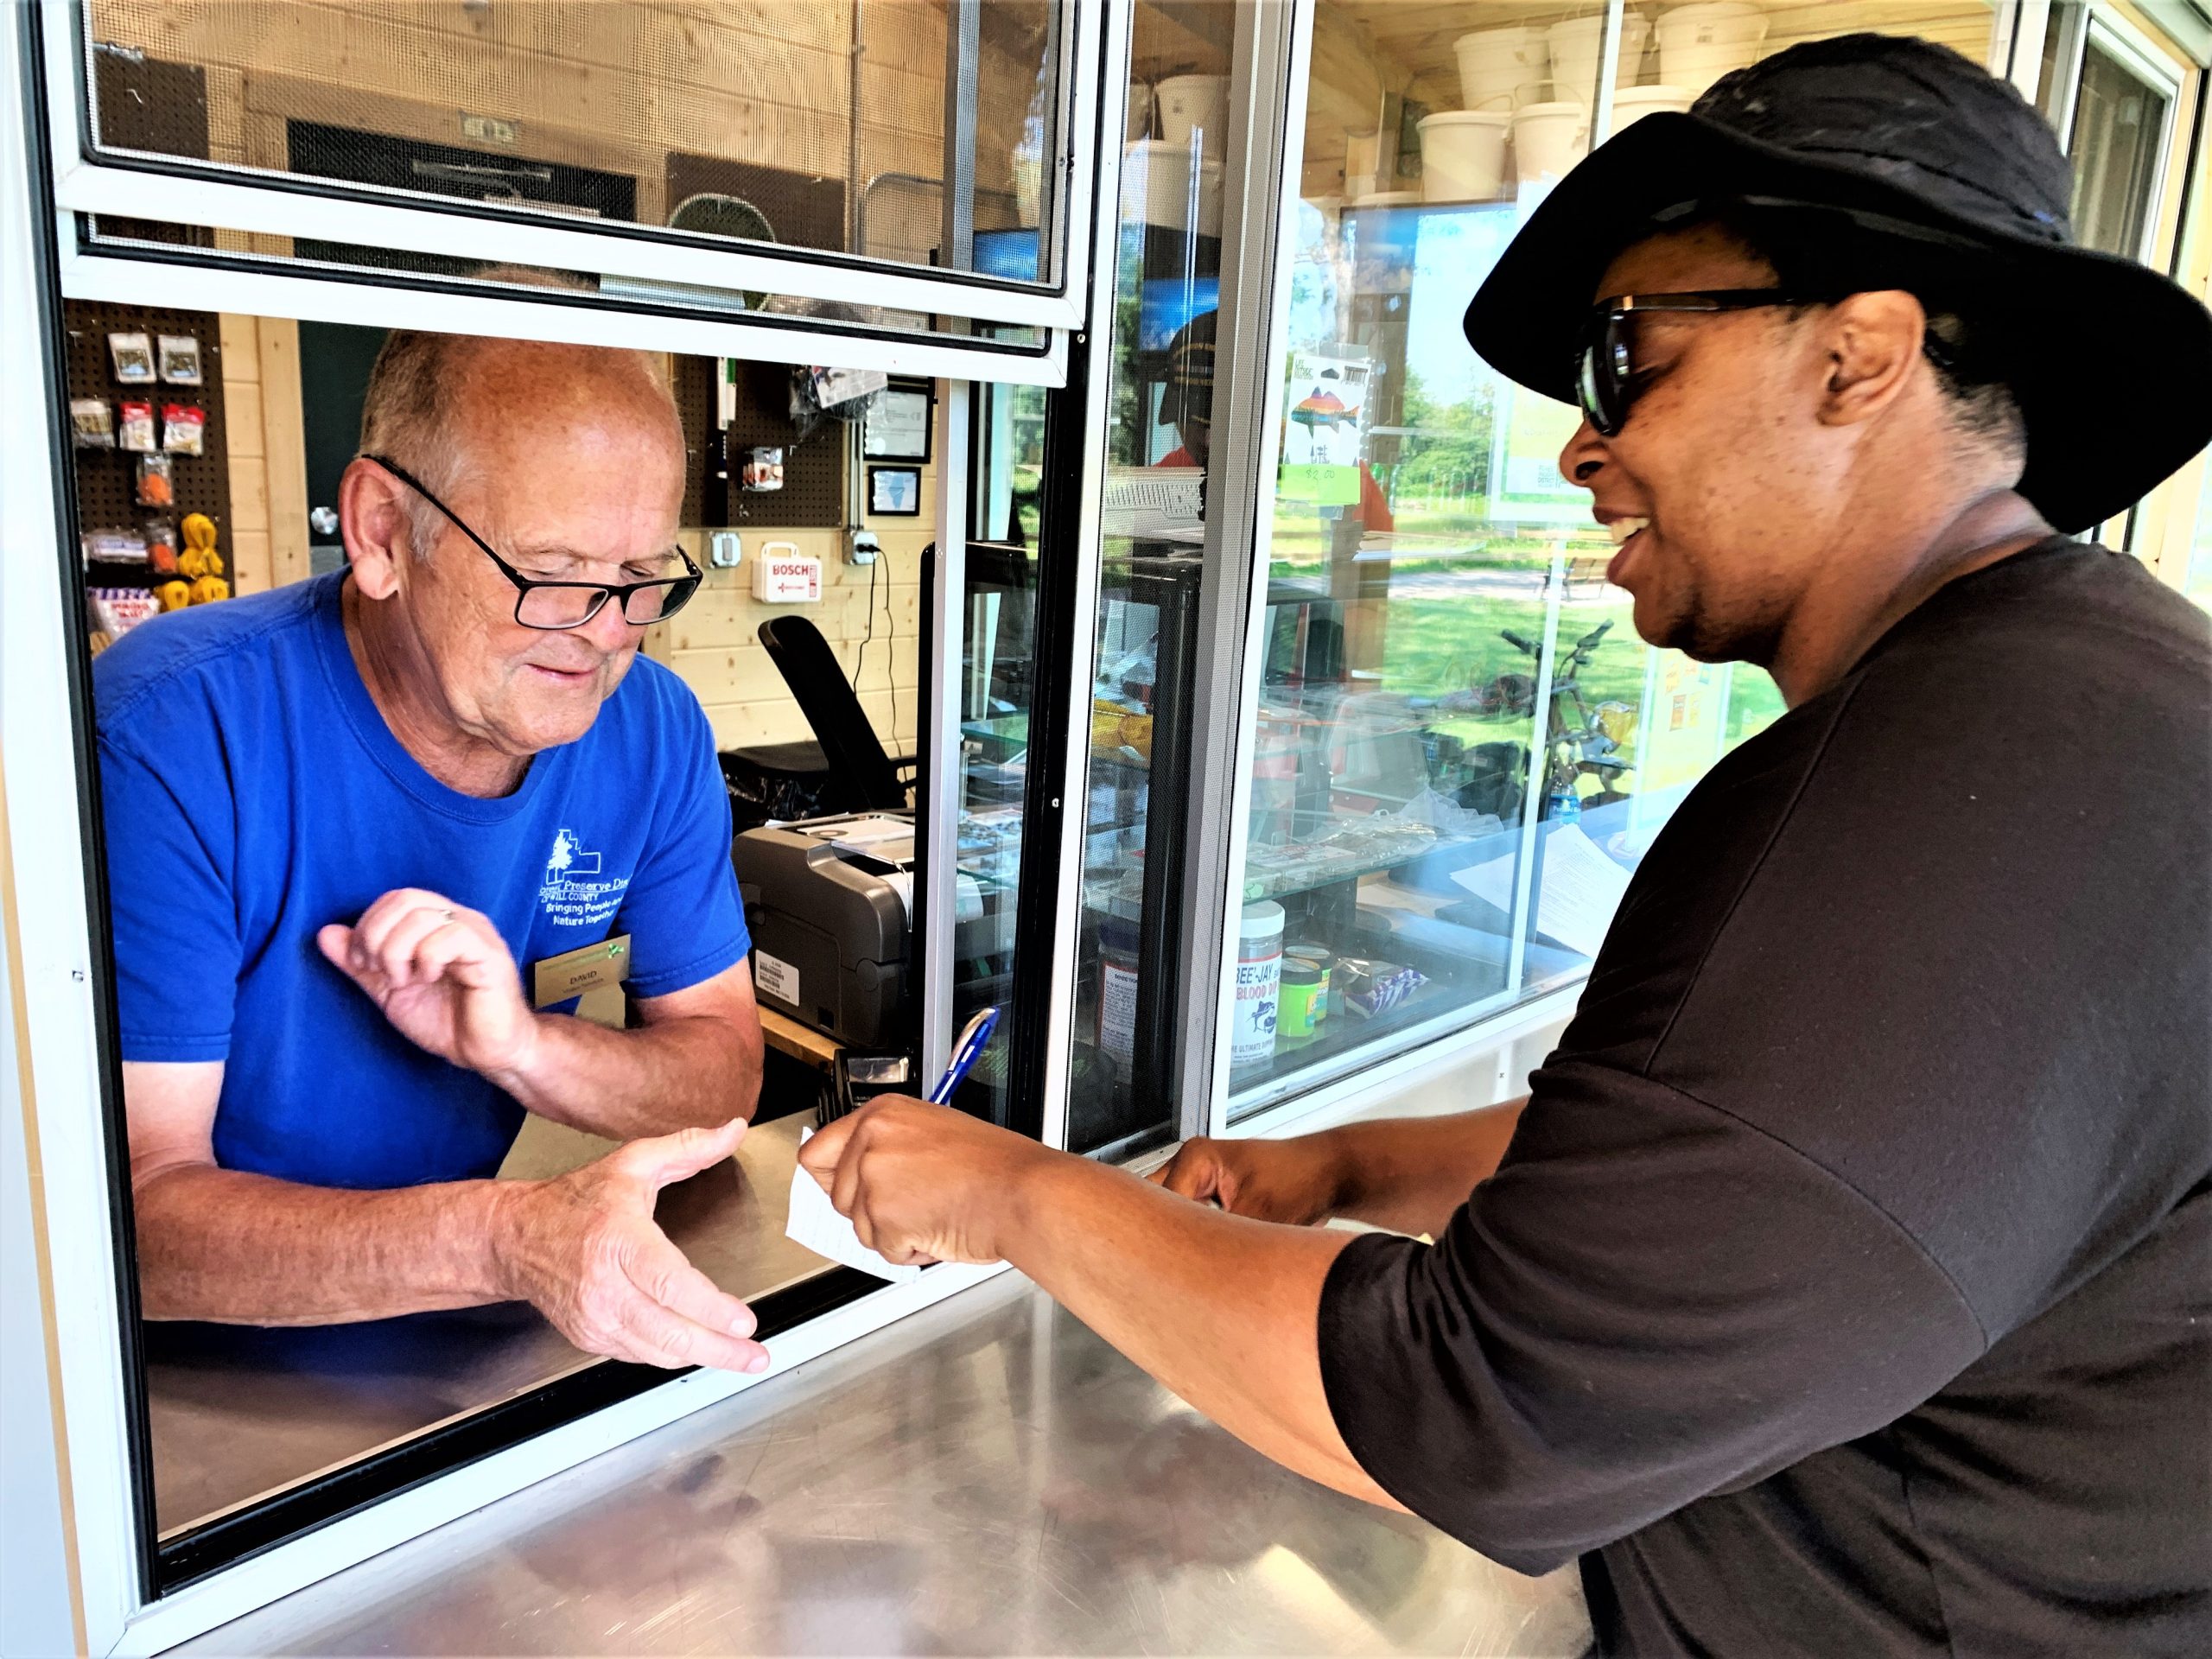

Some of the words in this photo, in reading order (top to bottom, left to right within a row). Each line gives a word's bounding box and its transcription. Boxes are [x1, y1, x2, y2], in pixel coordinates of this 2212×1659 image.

[772, 564, 809, 576] BOSCH
[564, 880, 611, 890] Preserve
[569, 893, 599, 901] COUNTY
[546, 903, 583, 915] Bringing
[585, 900, 612, 912] People
[554, 916, 584, 925] Nature
[570, 970, 597, 984] DAVID
[1236, 985, 1267, 1000] BLOOD
